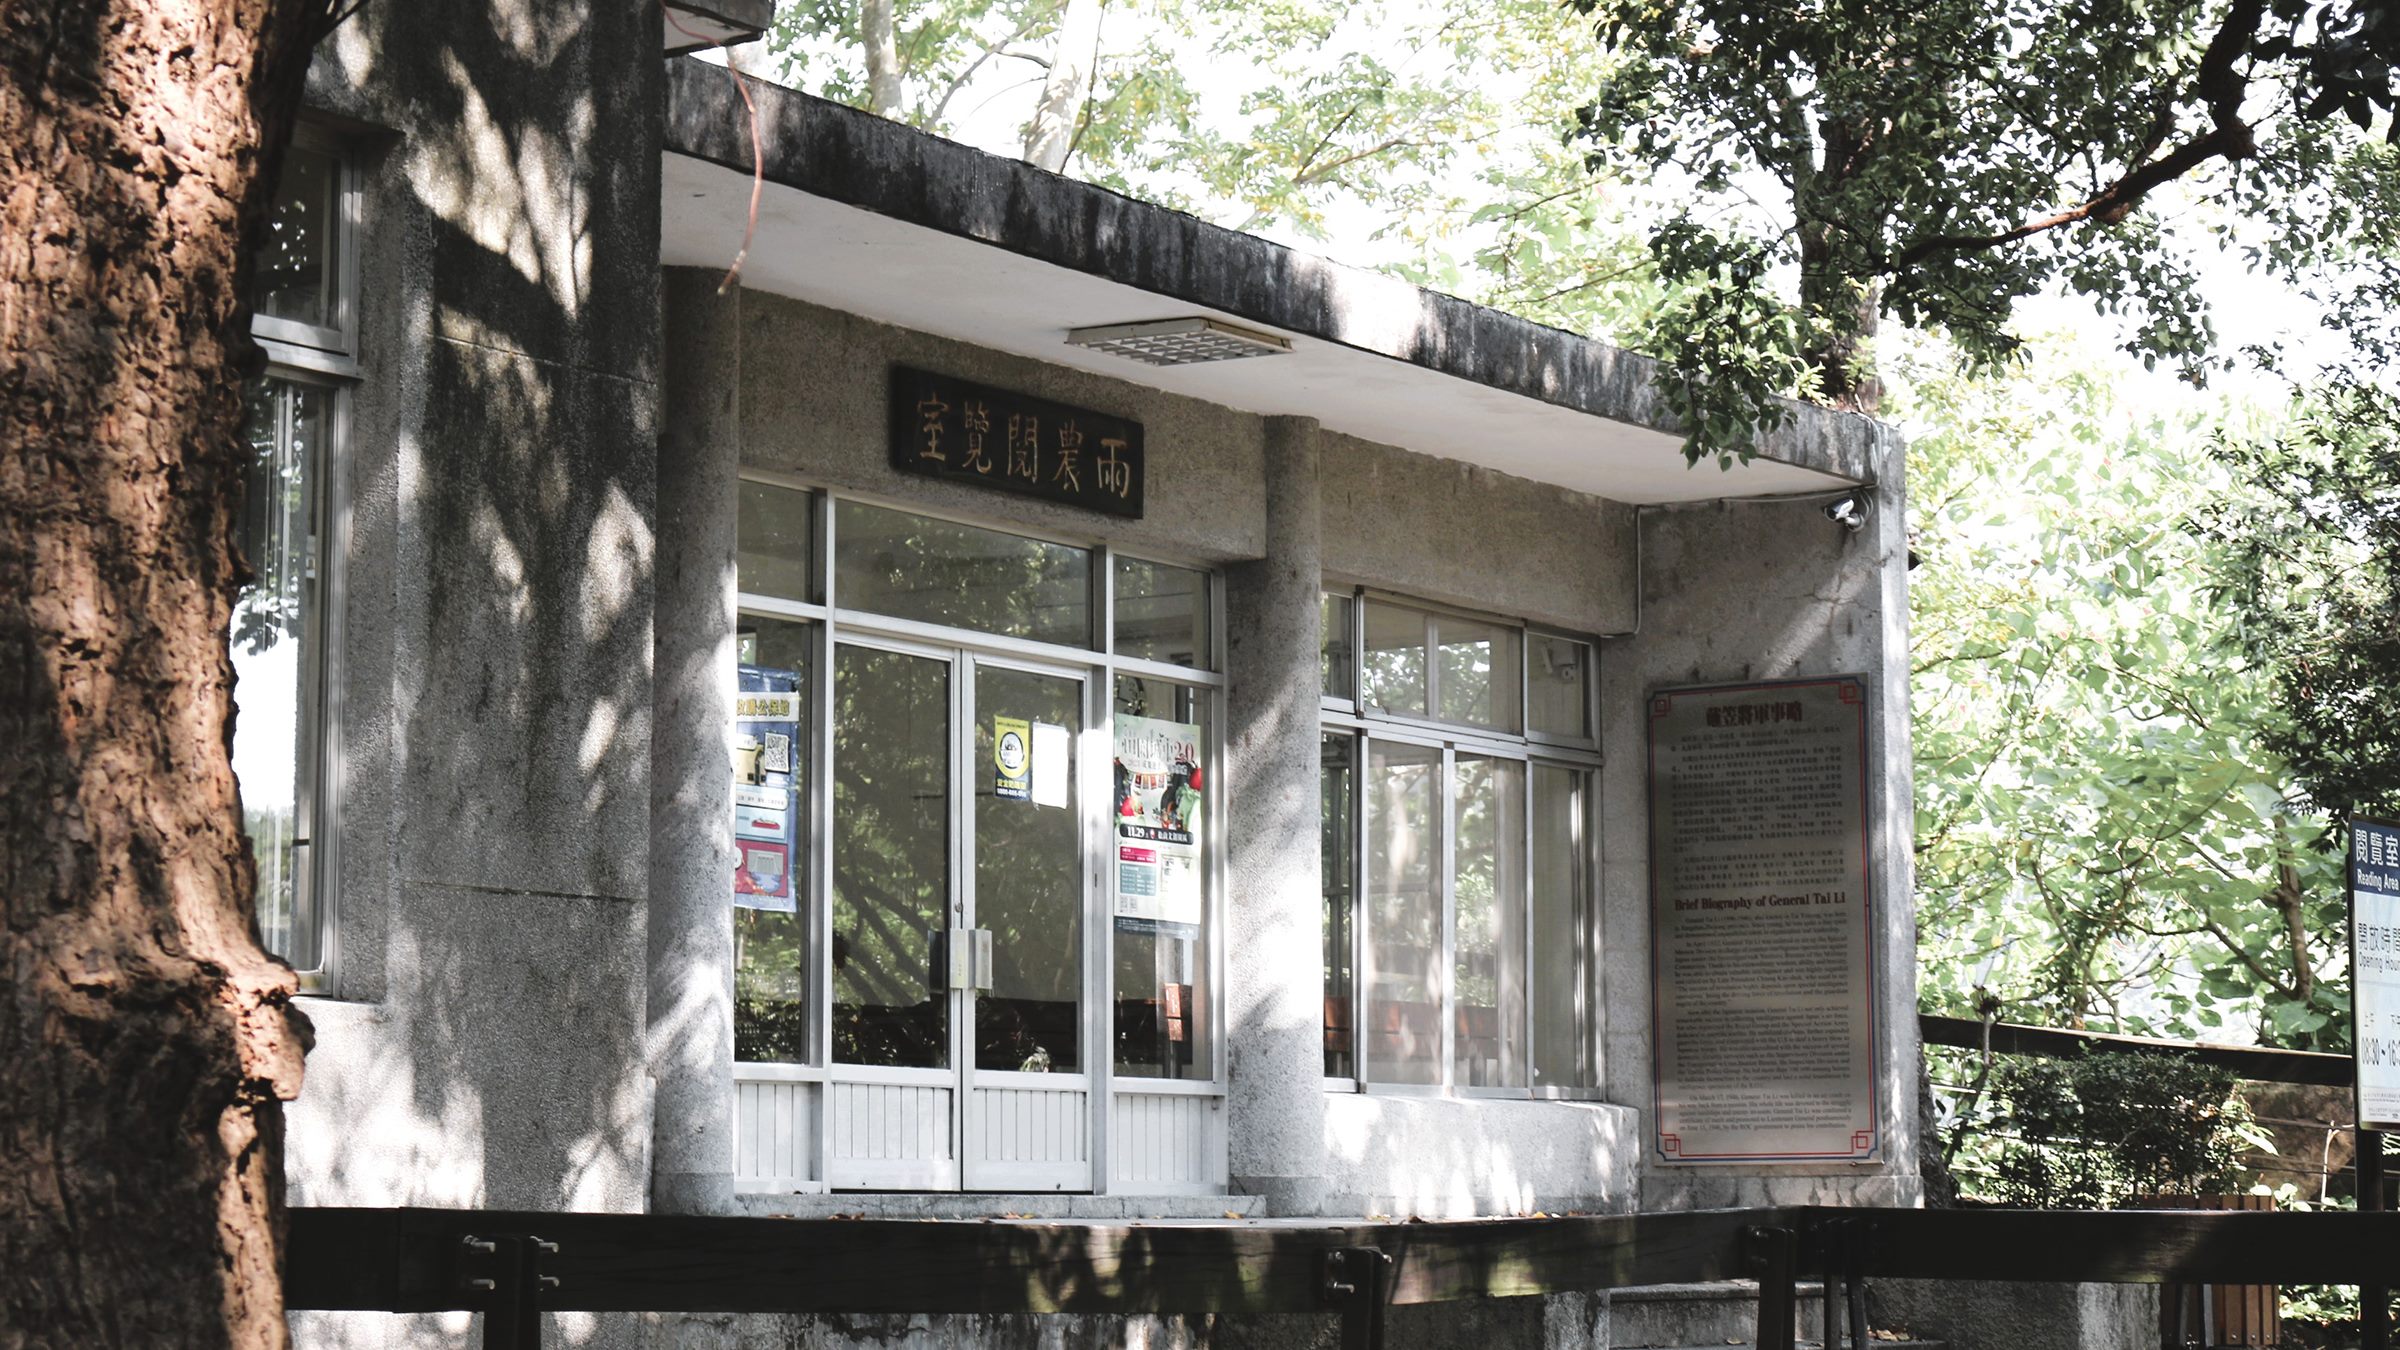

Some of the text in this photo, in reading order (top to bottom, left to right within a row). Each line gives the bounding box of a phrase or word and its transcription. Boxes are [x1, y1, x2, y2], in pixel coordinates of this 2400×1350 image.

[2355, 829, 2399, 868] 閱覽室
[2357, 868, 2400, 892] Reading Area
[1675, 892, 1846, 911] Brief Biography of General Tai Li
[2358, 951, 2383, 974] Opening
